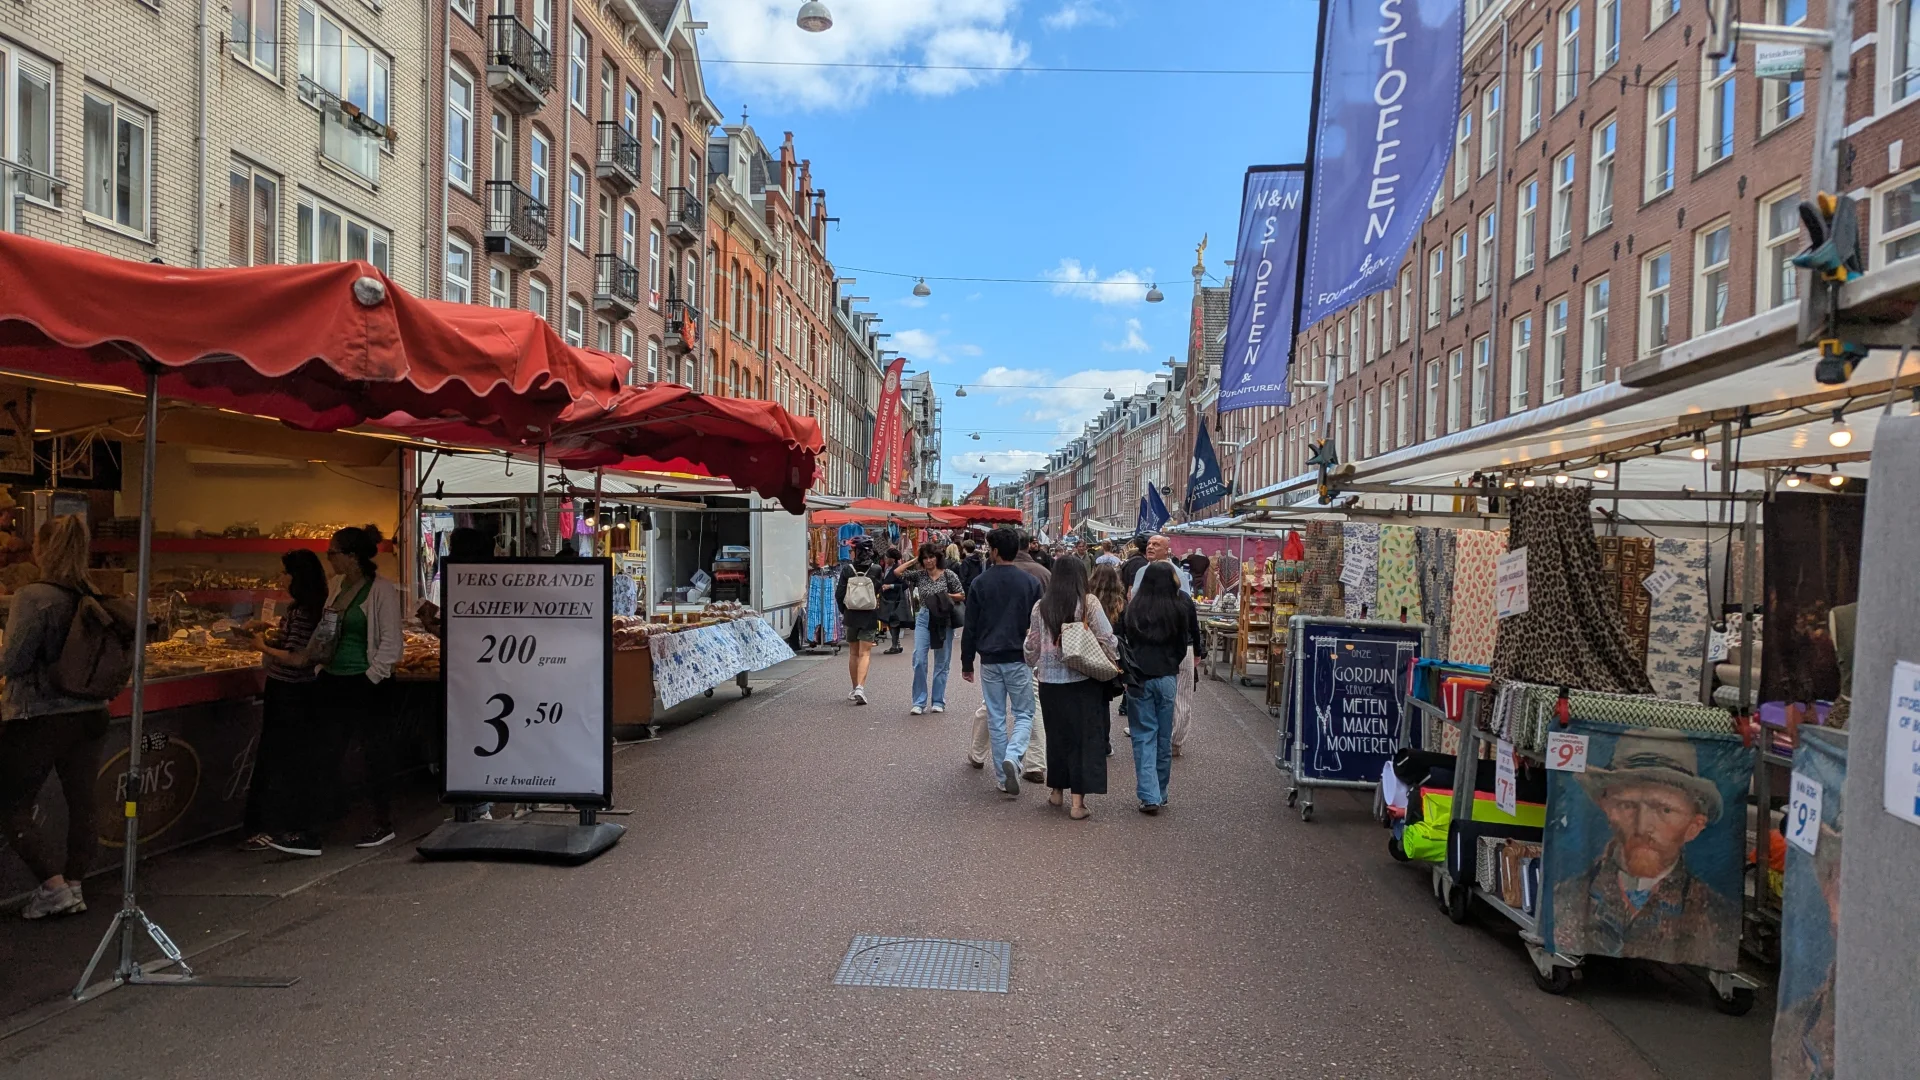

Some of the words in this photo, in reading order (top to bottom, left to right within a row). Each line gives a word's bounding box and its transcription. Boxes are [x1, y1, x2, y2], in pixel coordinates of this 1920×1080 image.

[1364, 0, 1408, 244] STOFFEN
[1254, 189, 1299, 210] N&N
[1360, 253, 1372, 272] &
[1244, 216, 1277, 365] STOFFEN
[1241, 372, 1252, 383] &
[872, 440, 882, 477] BENNY'S
[879, 398, 891, 437] CHICKEN
[456, 573, 498, 587] VERS
[502, 573, 596, 587] GEBRANDE
[453, 601, 529, 616] CASHEW
[531, 601, 594, 616] NOTEN
[476, 634, 537, 664] 200
[538, 656, 567, 667] gram
[1352, 649, 1372, 659] ONZE
[1335, 666, 1395, 685] GORDIJN
[1345, 685, 1373, 696] SERVICE
[1343, 697, 1387, 715] METEN
[1343, 717, 1388, 735] MAKEN
[1326, 735, 1399, 754] MONTEREN
[116, 760, 175, 802] RN'S
[484, 774, 490, 785] 1
[493, 775, 508, 785] ste
[511, 774, 557, 786] kwaliteit
